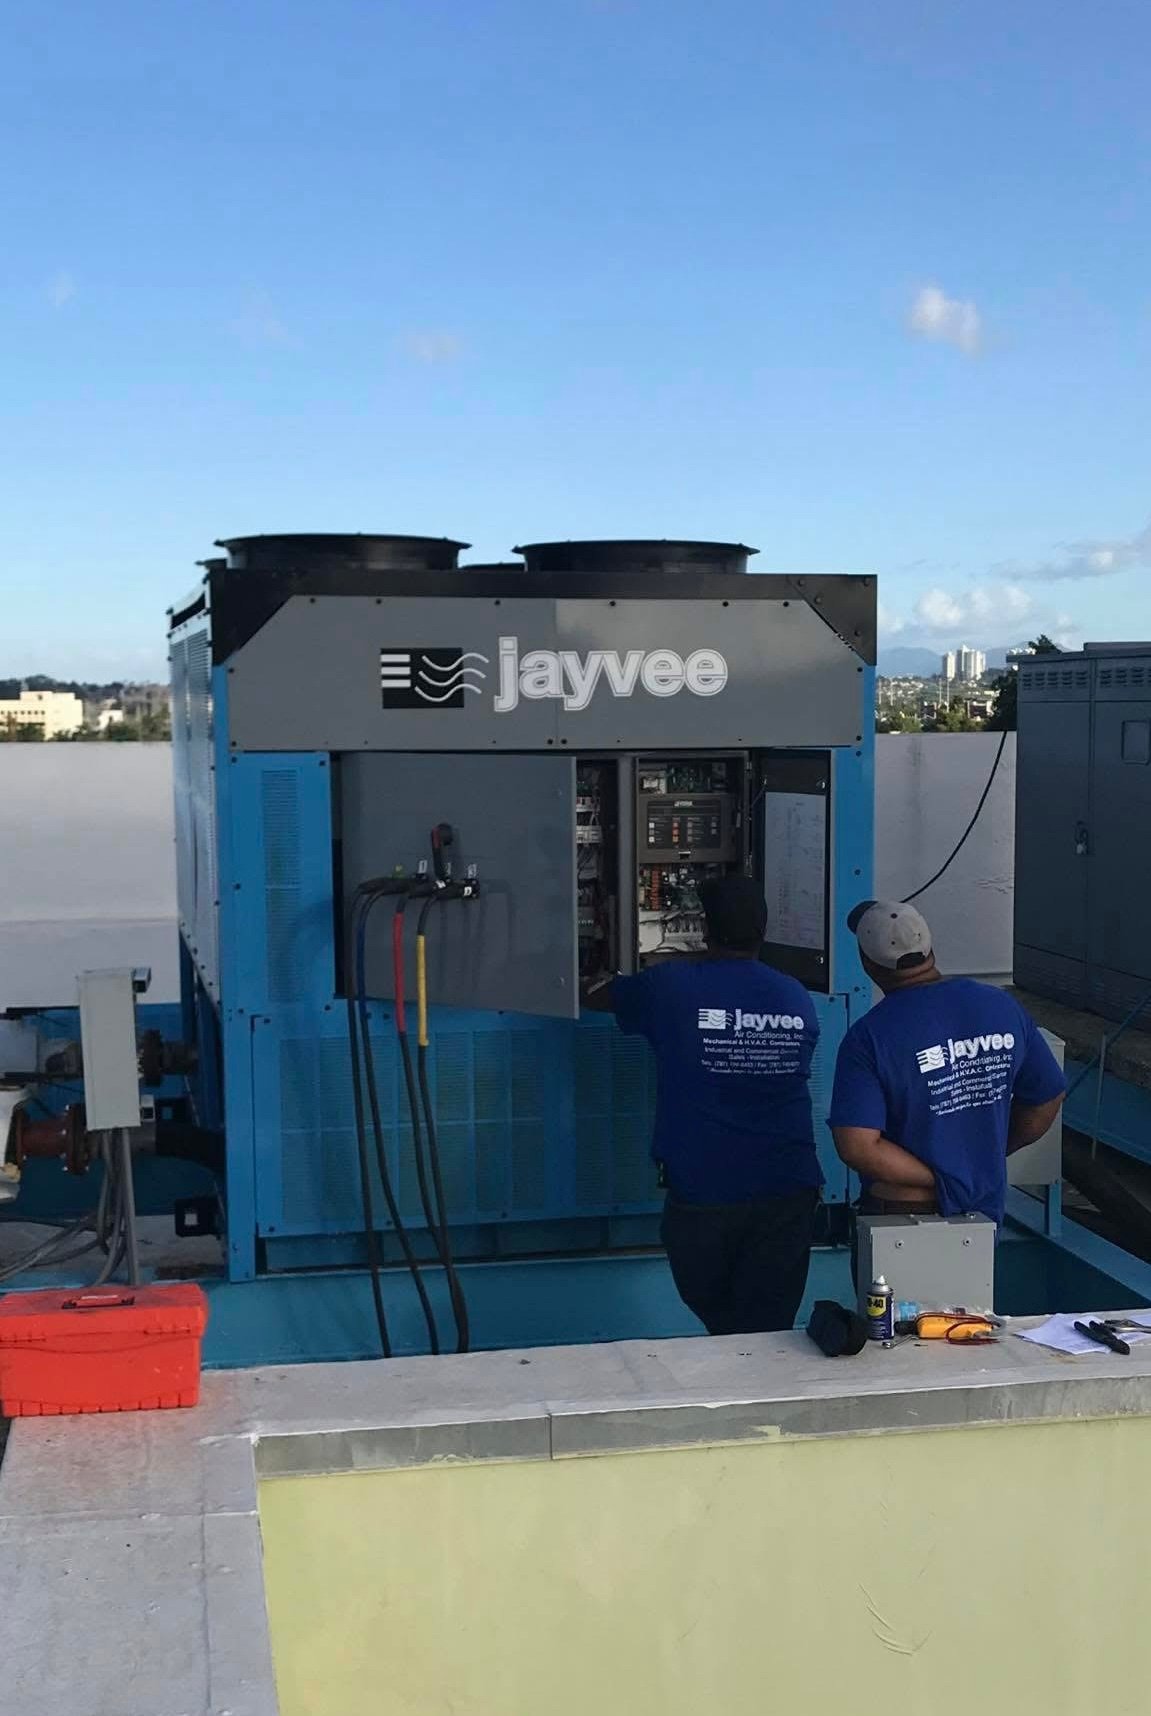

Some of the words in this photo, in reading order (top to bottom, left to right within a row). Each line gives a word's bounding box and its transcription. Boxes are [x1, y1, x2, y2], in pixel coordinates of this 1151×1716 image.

[494, 636, 728, 712] jayvee
[734, 1008, 804, 1031] jayvee
[948, 1033, 1014, 1064] jayvee
